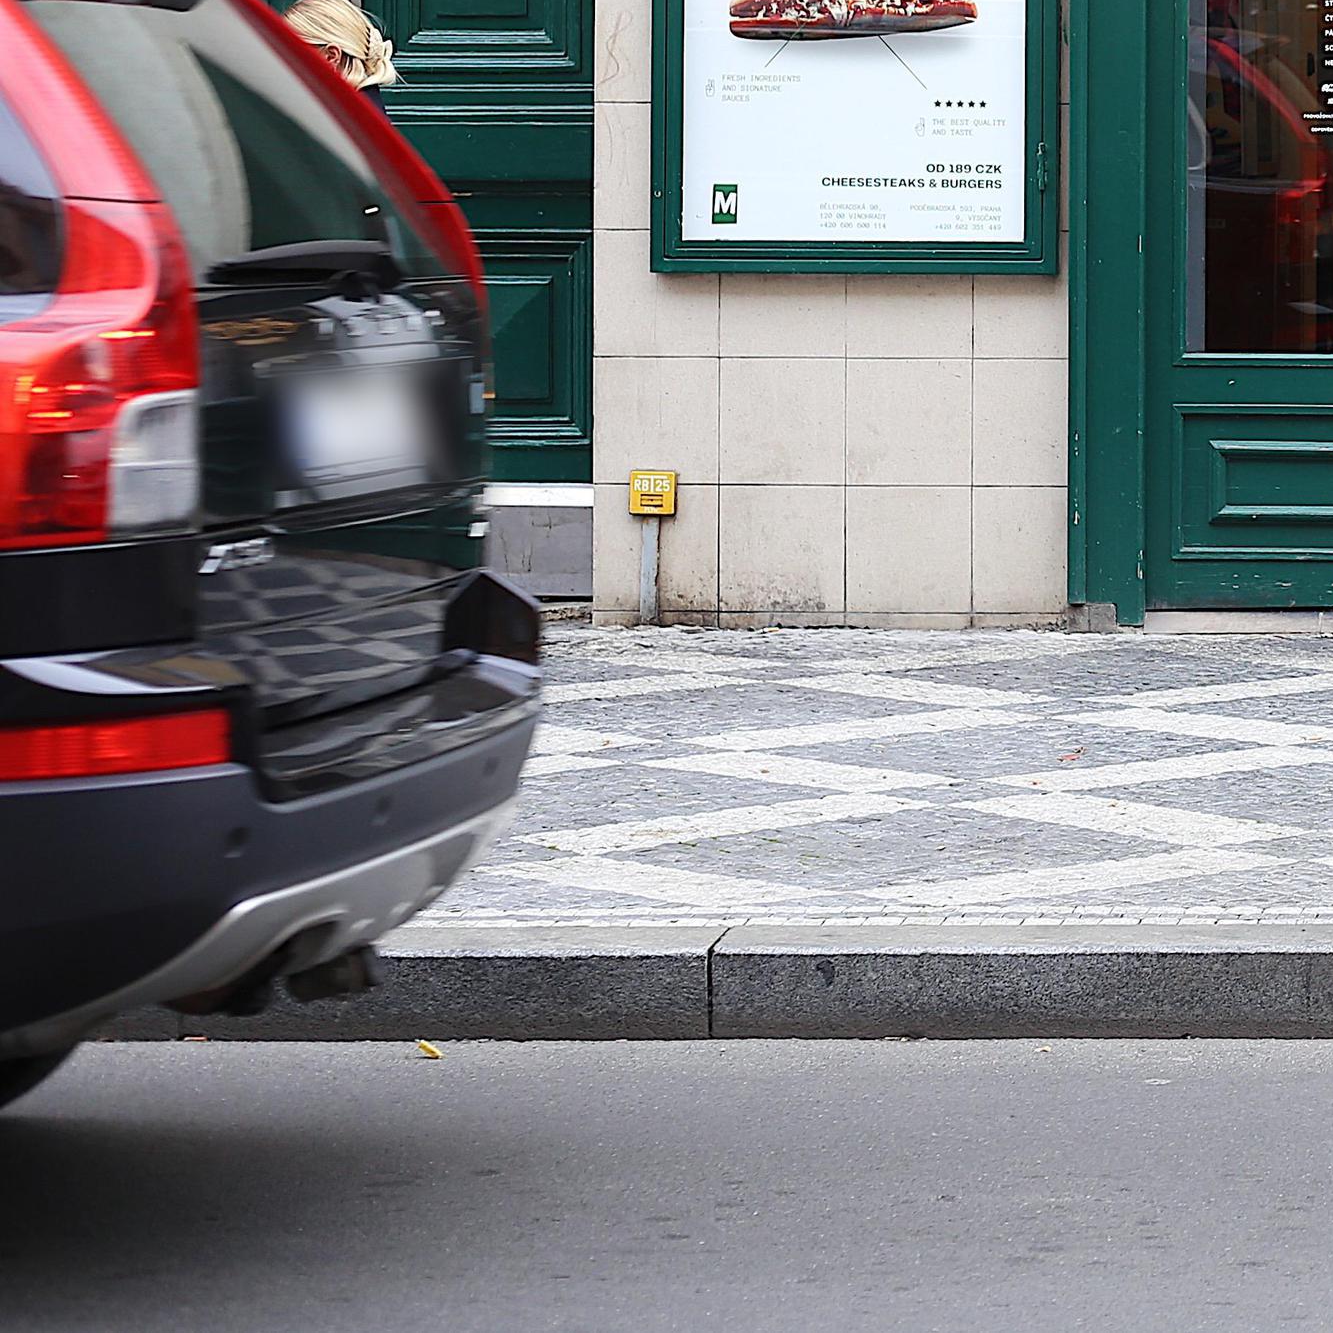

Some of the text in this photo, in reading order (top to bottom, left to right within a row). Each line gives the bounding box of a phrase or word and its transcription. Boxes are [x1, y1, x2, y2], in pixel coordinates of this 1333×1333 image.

[721, 74, 746, 82] FRESH
[721, 84, 737, 92] AND
[721, 94, 750, 102] SAUCES
[932, 118, 945, 126] THE
[950, 118, 969, 126] BEST
[931, 128, 946, 136] AND
[926, 163, 1002, 174] OD 189 CZK
[821, 176, 1002, 189] CHEESESTEAKS & BURGERS
[714, 190, 737, 215] M
[633, 479, 671, 492] RB 25
